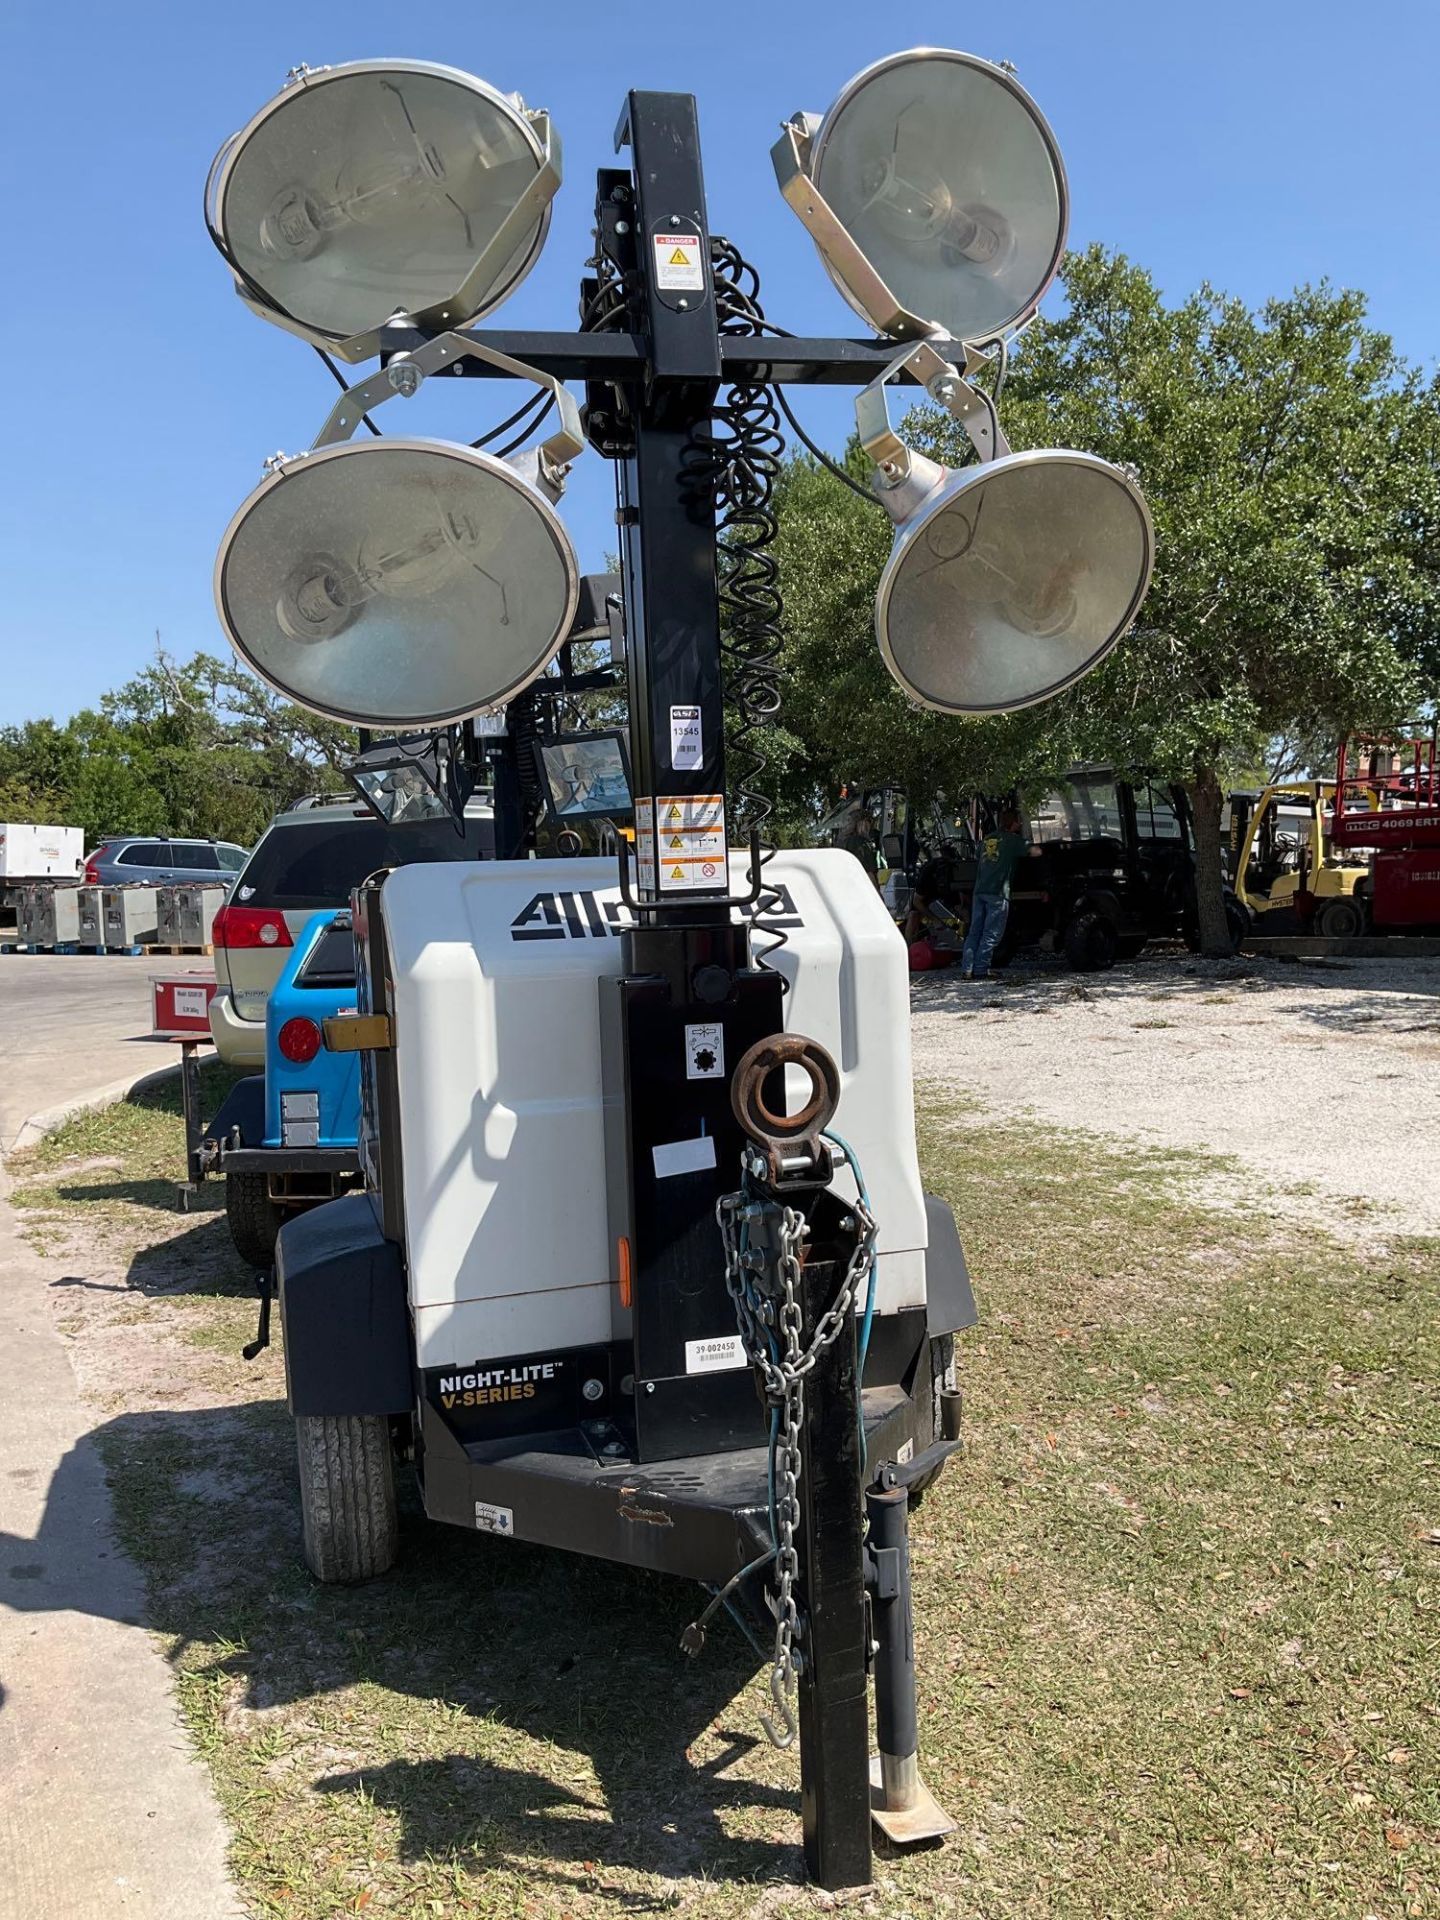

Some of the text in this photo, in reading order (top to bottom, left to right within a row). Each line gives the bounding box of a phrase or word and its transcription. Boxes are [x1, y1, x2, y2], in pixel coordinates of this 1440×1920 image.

[665, 237, 694, 245] DANGER
[673, 727, 700, 736] 13545
[1382, 820, 1413, 828] 4069
[1230, 814, 1239, 851] HYSTER
[441, 1383, 535, 1408] V-SERIES
